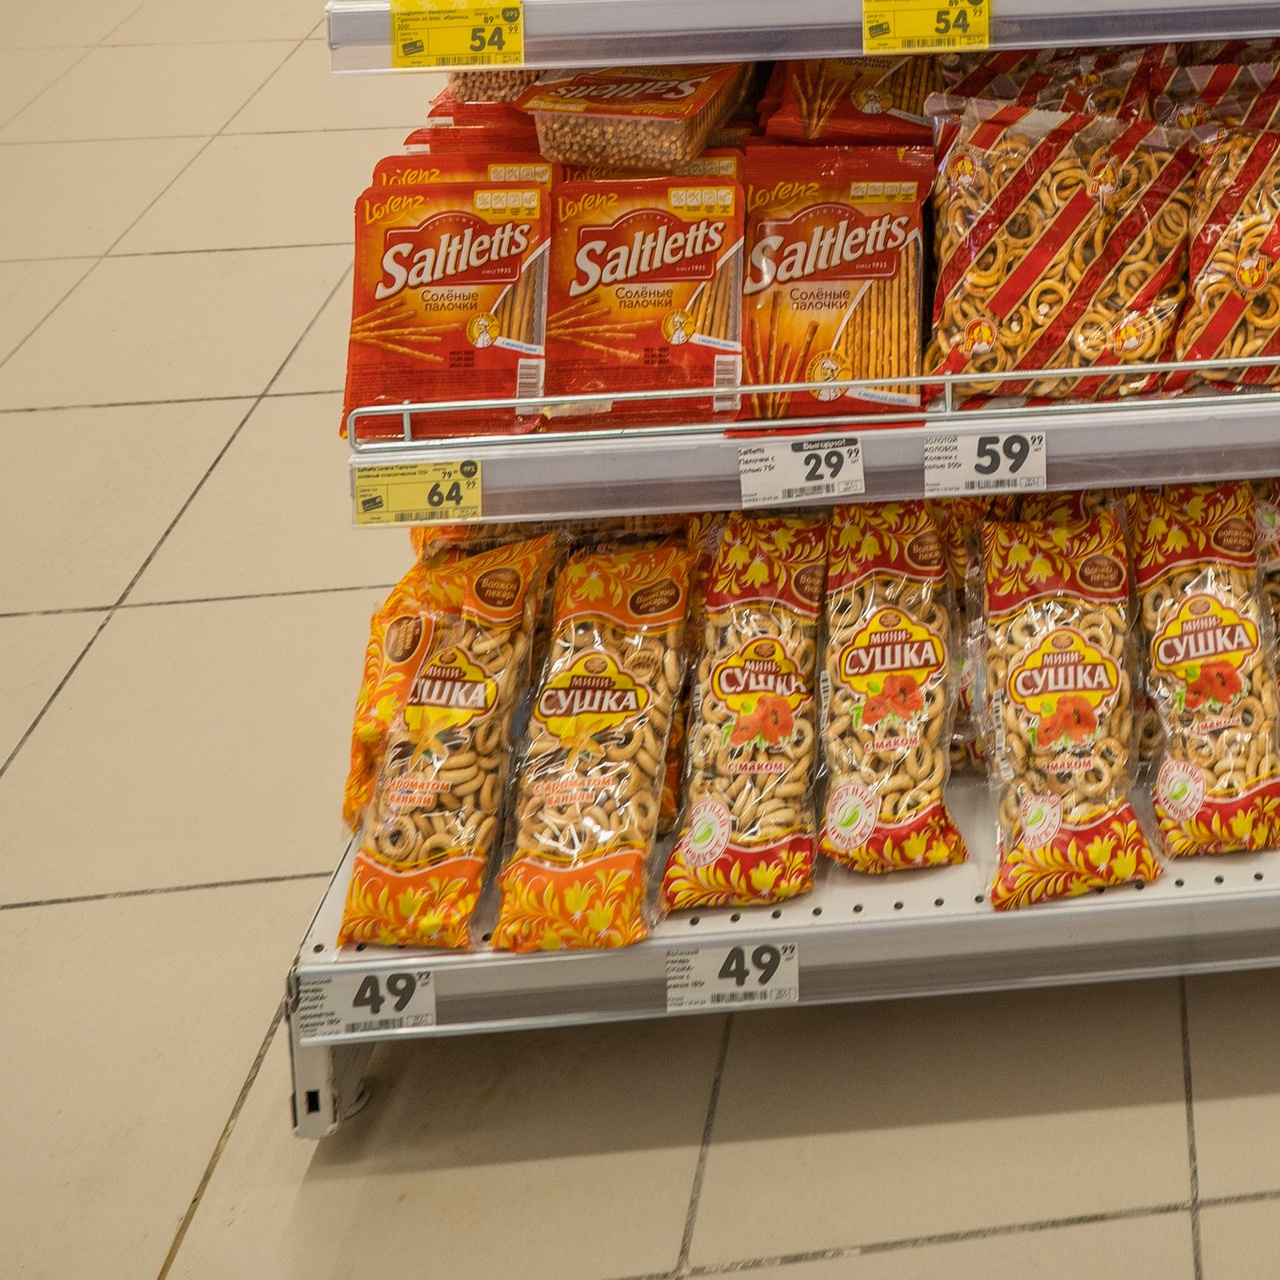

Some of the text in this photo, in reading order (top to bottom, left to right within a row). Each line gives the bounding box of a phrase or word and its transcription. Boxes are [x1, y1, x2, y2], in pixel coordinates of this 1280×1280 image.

[935, 10, 970, 34] 54
[470, 26, 518, 52] 54 99
[364, 194, 425, 223] Lorenz
[558, 193, 620, 222] Lorenz
[375, 222, 530, 299] Saltletts
[569, 219, 723, 297] Saltletts
[744, 215, 908, 295] Saltletts
[421, 287, 479, 302] Солёные
[424, 299, 479, 312] палочки
[803, 441, 846, 450] Выгодно!
[975, 435, 1043, 475] 59 99
[803, 449, 860, 481] 29 99
[428, 482, 463, 507] 64
[1159, 624, 1252, 662] СУШКА
[1016, 663, 1112, 696] СУШКА
[541, 689, 638, 716] СУШКА
[740, 761, 784, 773] маком
[719, 947, 781, 986] 49
[353, 974, 418, 1012] 49
